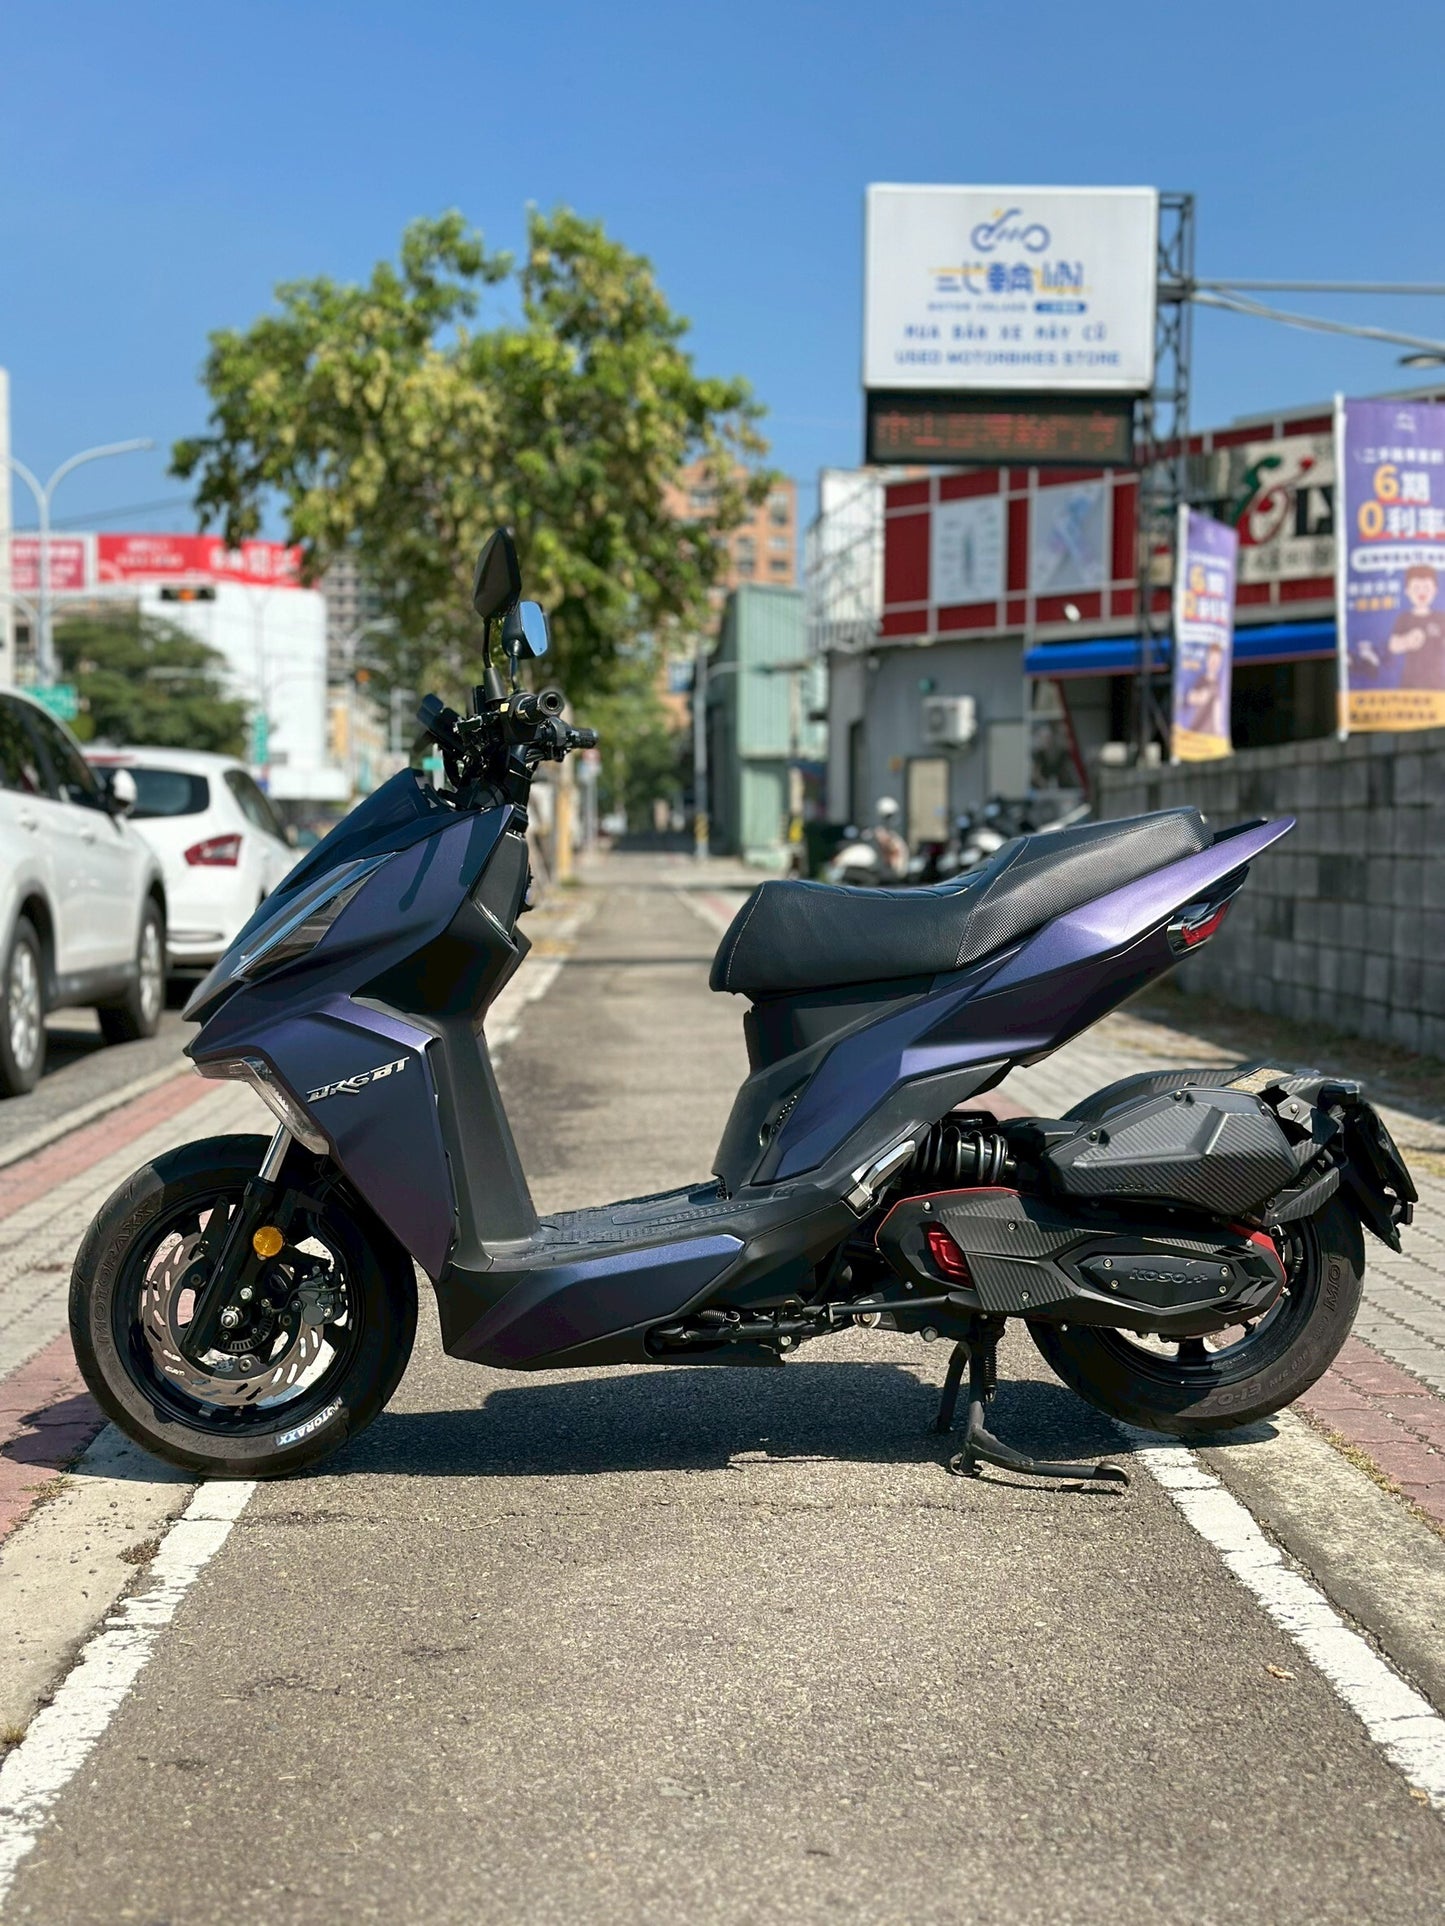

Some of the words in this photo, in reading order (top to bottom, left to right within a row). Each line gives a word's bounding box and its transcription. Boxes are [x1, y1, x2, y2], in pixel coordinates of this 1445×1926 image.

[895, 350, 942, 366] USED
[1129, 1267, 1187, 1284] KOSO
[276, 1396, 344, 1447] MOTORAXX
